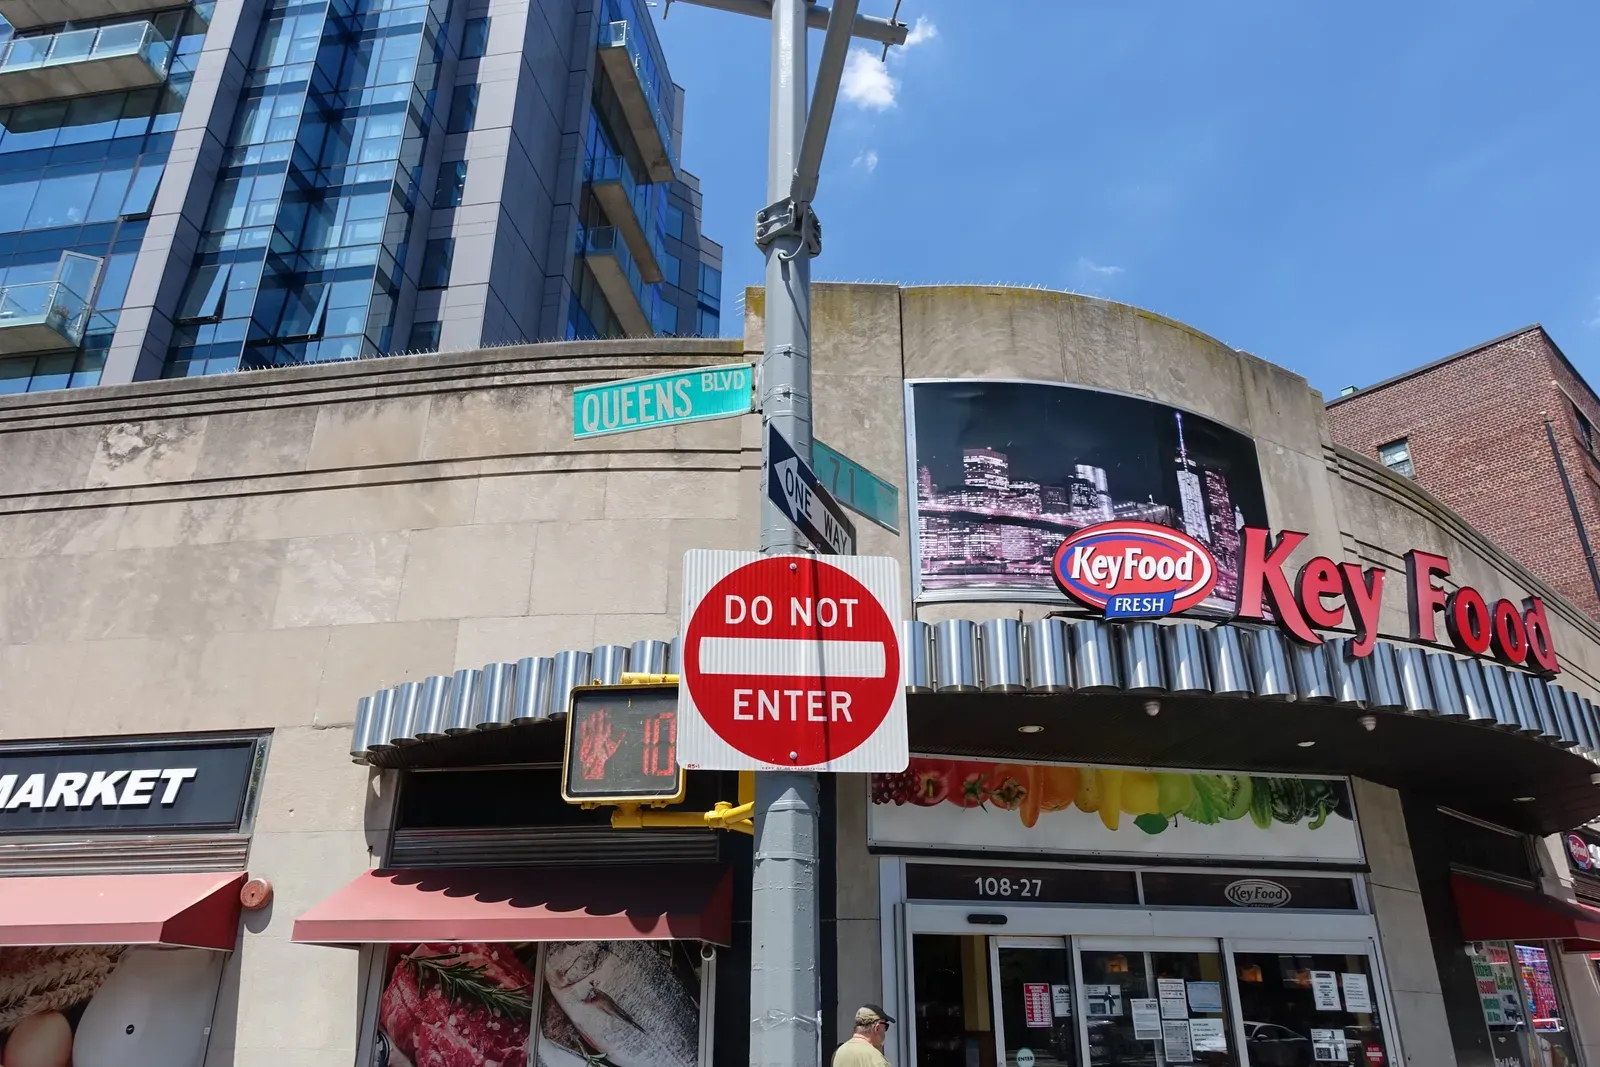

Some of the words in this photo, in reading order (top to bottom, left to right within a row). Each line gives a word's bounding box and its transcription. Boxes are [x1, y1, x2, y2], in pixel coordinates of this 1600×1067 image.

[582, 379, 692, 432] QUEENS
[701, 370, 746, 393] BLVD
[829, 457, 855, 506] 71
[785, 467, 812, 520] ONE
[823, 509, 849, 555] WAY
[725, 594, 773, 625] DO
[791, 597, 859, 628] NOT
[1113, 597, 1165, 613] FRESH
[1238, 526, 1386, 660] Key
[1404, 548, 1560, 680] Food
[733, 688, 853, 722] ENTER
[974, 877, 1042, 898] 108-27
